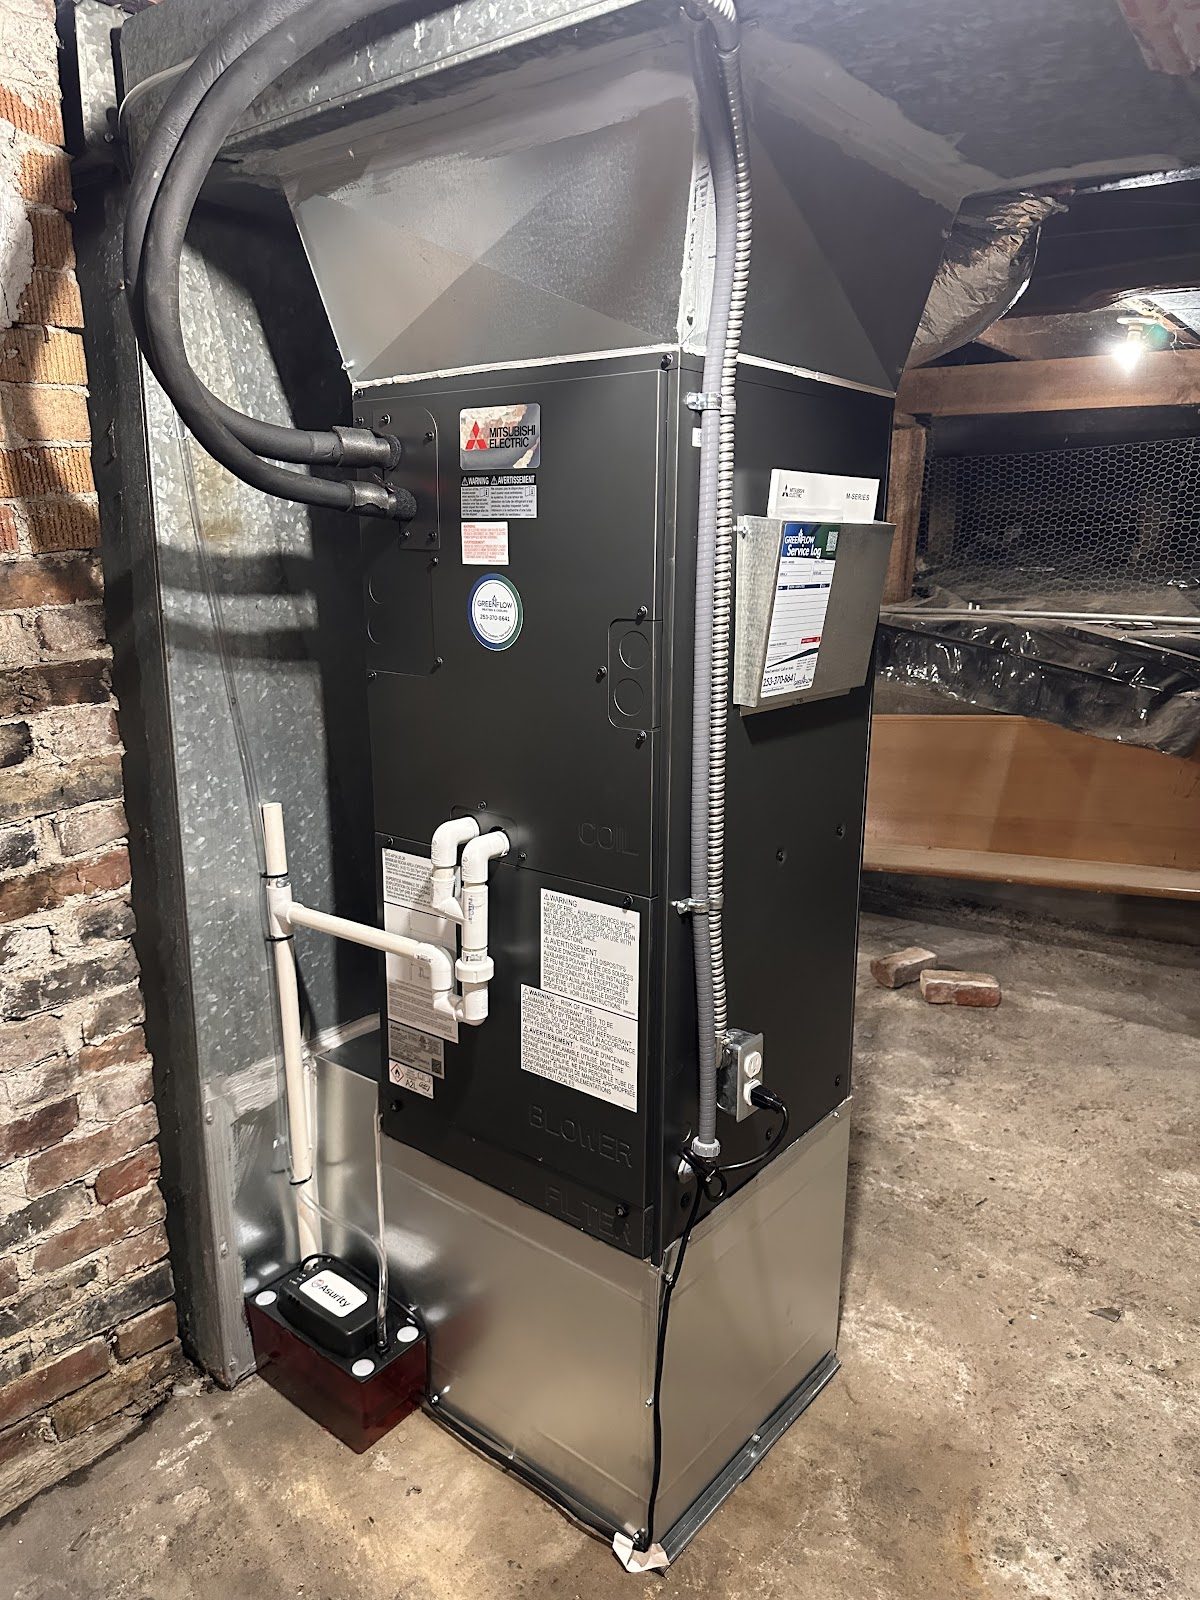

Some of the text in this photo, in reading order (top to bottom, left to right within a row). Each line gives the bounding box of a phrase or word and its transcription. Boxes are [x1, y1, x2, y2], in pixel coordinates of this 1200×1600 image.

[489, 425, 536, 438] MITSUBISHI
[489, 437, 529, 449] ELECTRIC
[468, 476, 490, 486] WARNING
[498, 475, 535, 484] AVERTISSEMENT
[846, 492, 870, 500] M-SERIES
[784, 535, 815, 544] GREENFLOW
[786, 544, 822, 559] Service Log
[477, 600, 512, 608] GREENFLOW
[578, 822, 639, 856] COIL
[406, 1080, 418, 1090] A2L
[530, 1104, 632, 1168] BLOWER
[319, 1284, 351, 1308] Asurity
